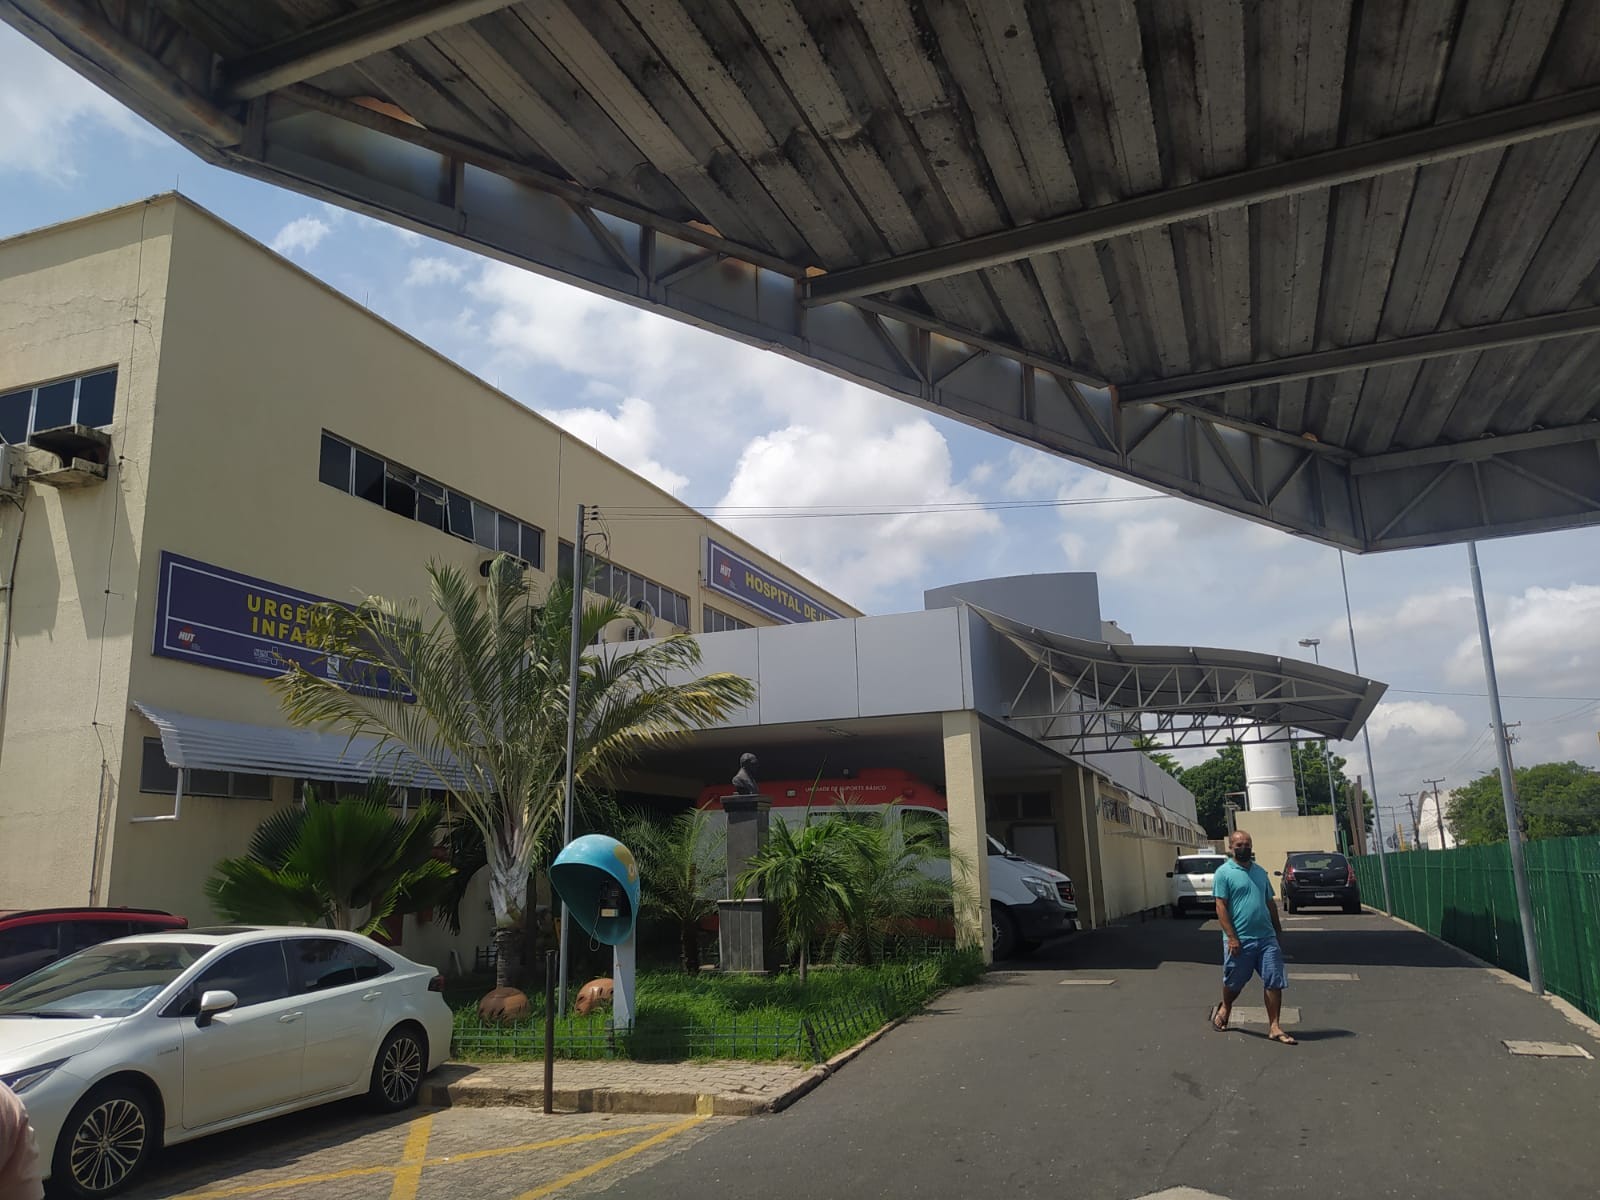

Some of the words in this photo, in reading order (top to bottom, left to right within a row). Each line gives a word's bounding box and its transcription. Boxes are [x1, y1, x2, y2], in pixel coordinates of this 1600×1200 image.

[247, 593, 344, 632] URGÊN
[745, 570, 801, 615] HOSPITAL
[803, 603, 817, 622] DE
[178, 631, 196, 642] HUT
